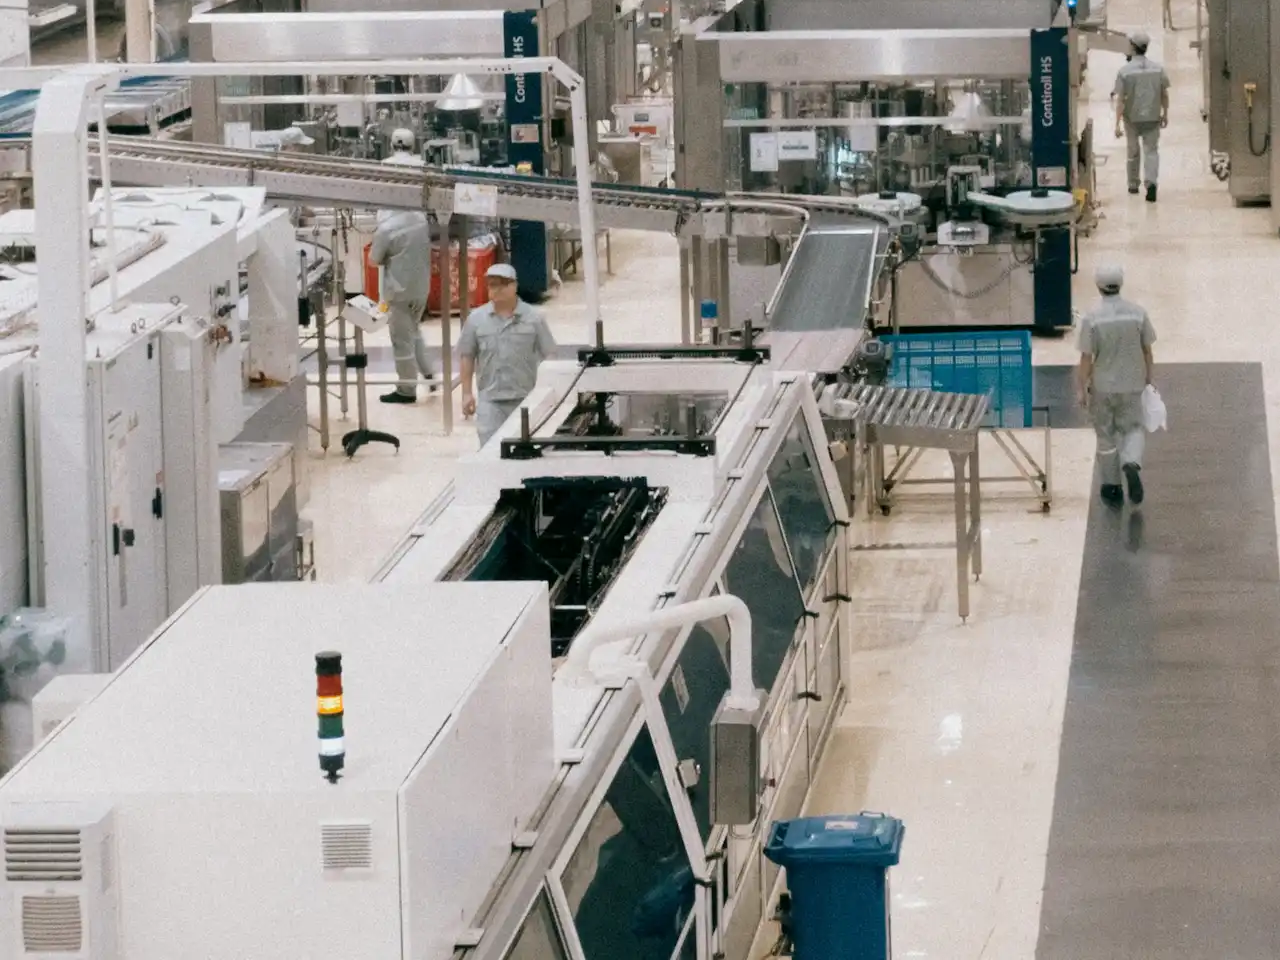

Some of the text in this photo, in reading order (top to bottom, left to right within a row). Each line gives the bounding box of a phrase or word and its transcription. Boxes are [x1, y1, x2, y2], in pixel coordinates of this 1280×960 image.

[512, 35, 524, 52] HS
[1040, 55, 1053, 127] Contiroll HS
